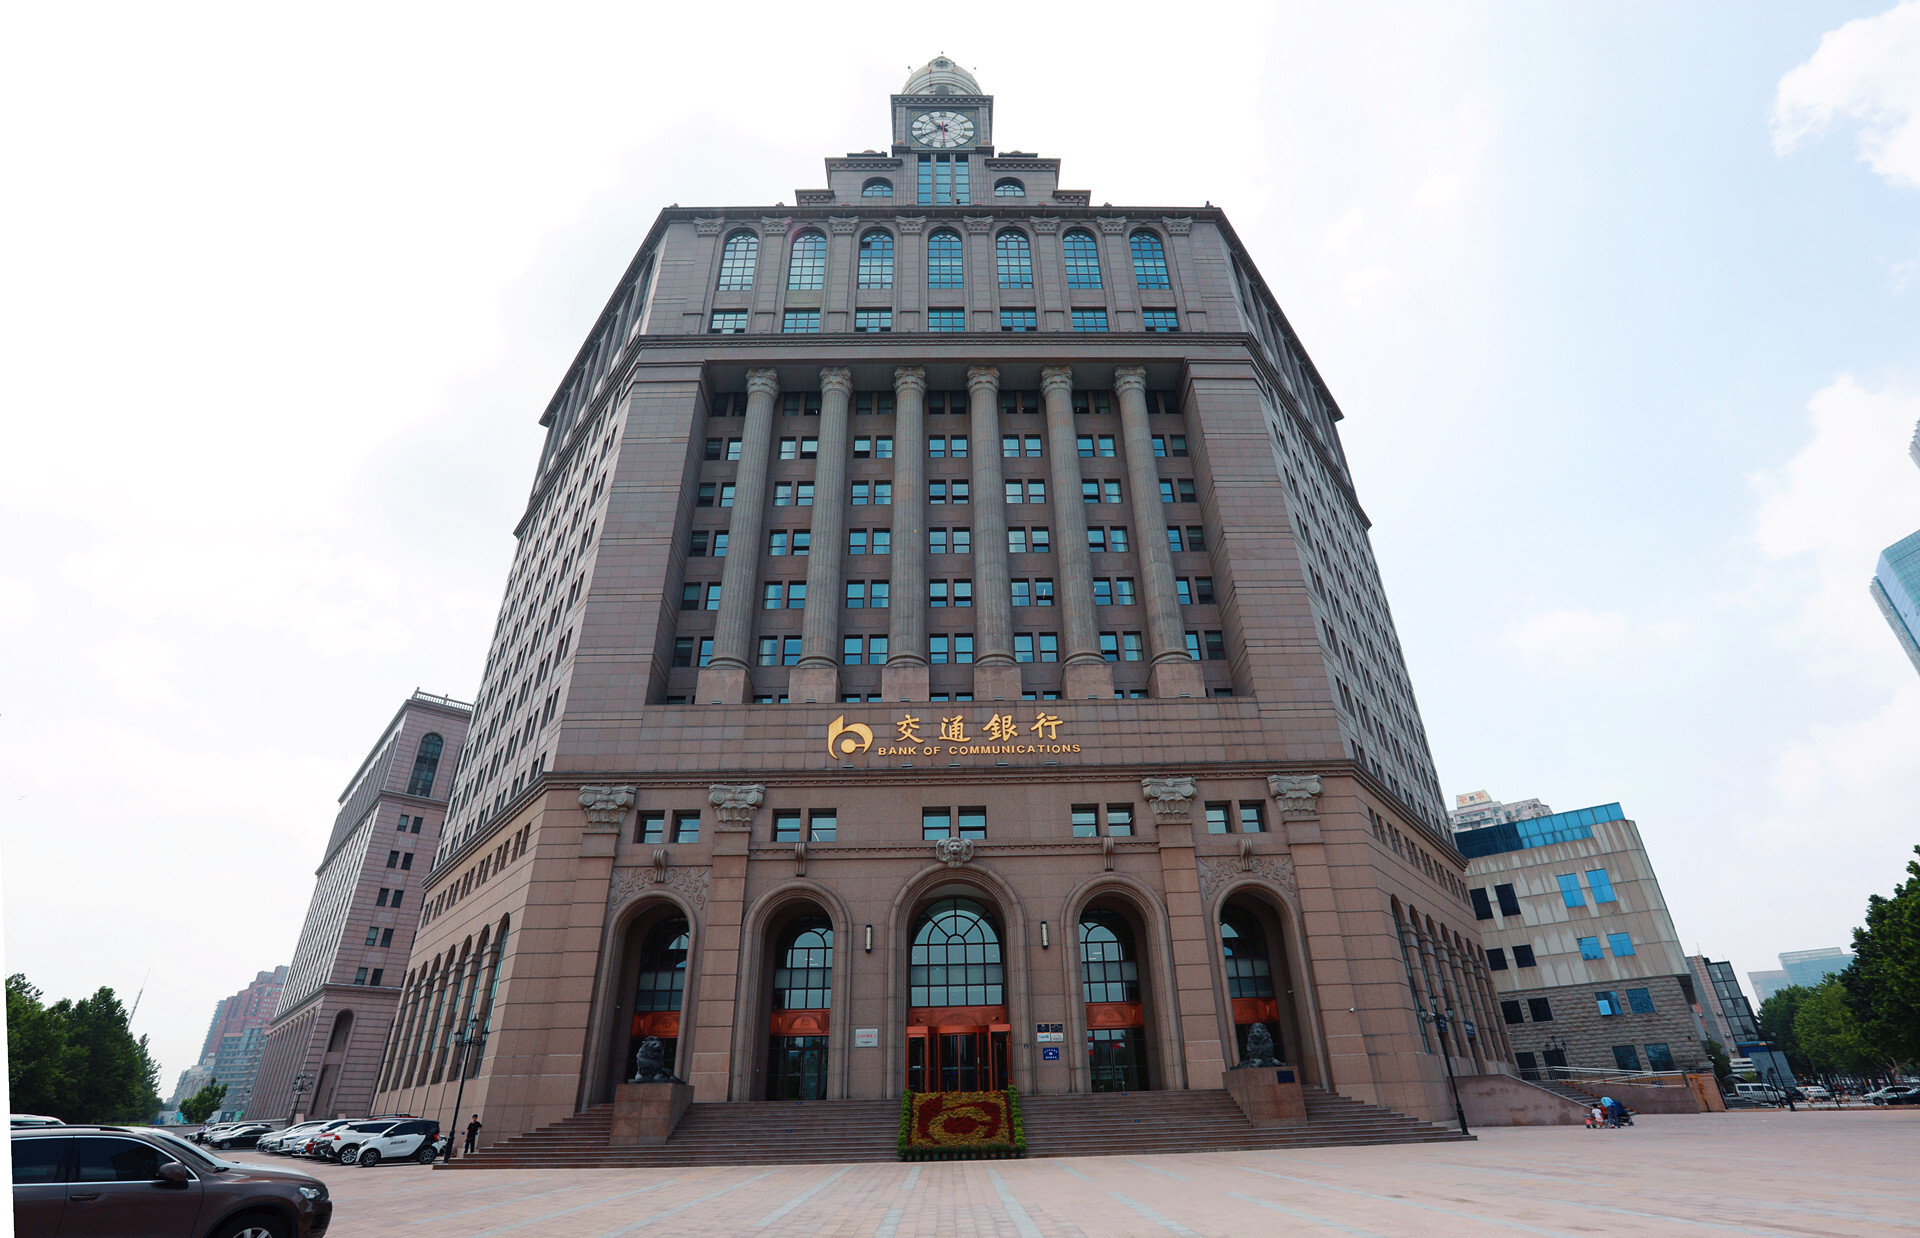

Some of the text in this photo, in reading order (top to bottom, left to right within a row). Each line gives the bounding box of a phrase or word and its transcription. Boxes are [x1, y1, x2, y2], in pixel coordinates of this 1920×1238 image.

[896, 712, 1063, 743] 交通銀行
[878, 744, 1081, 756] BANK OF COMMUNICATIONS
